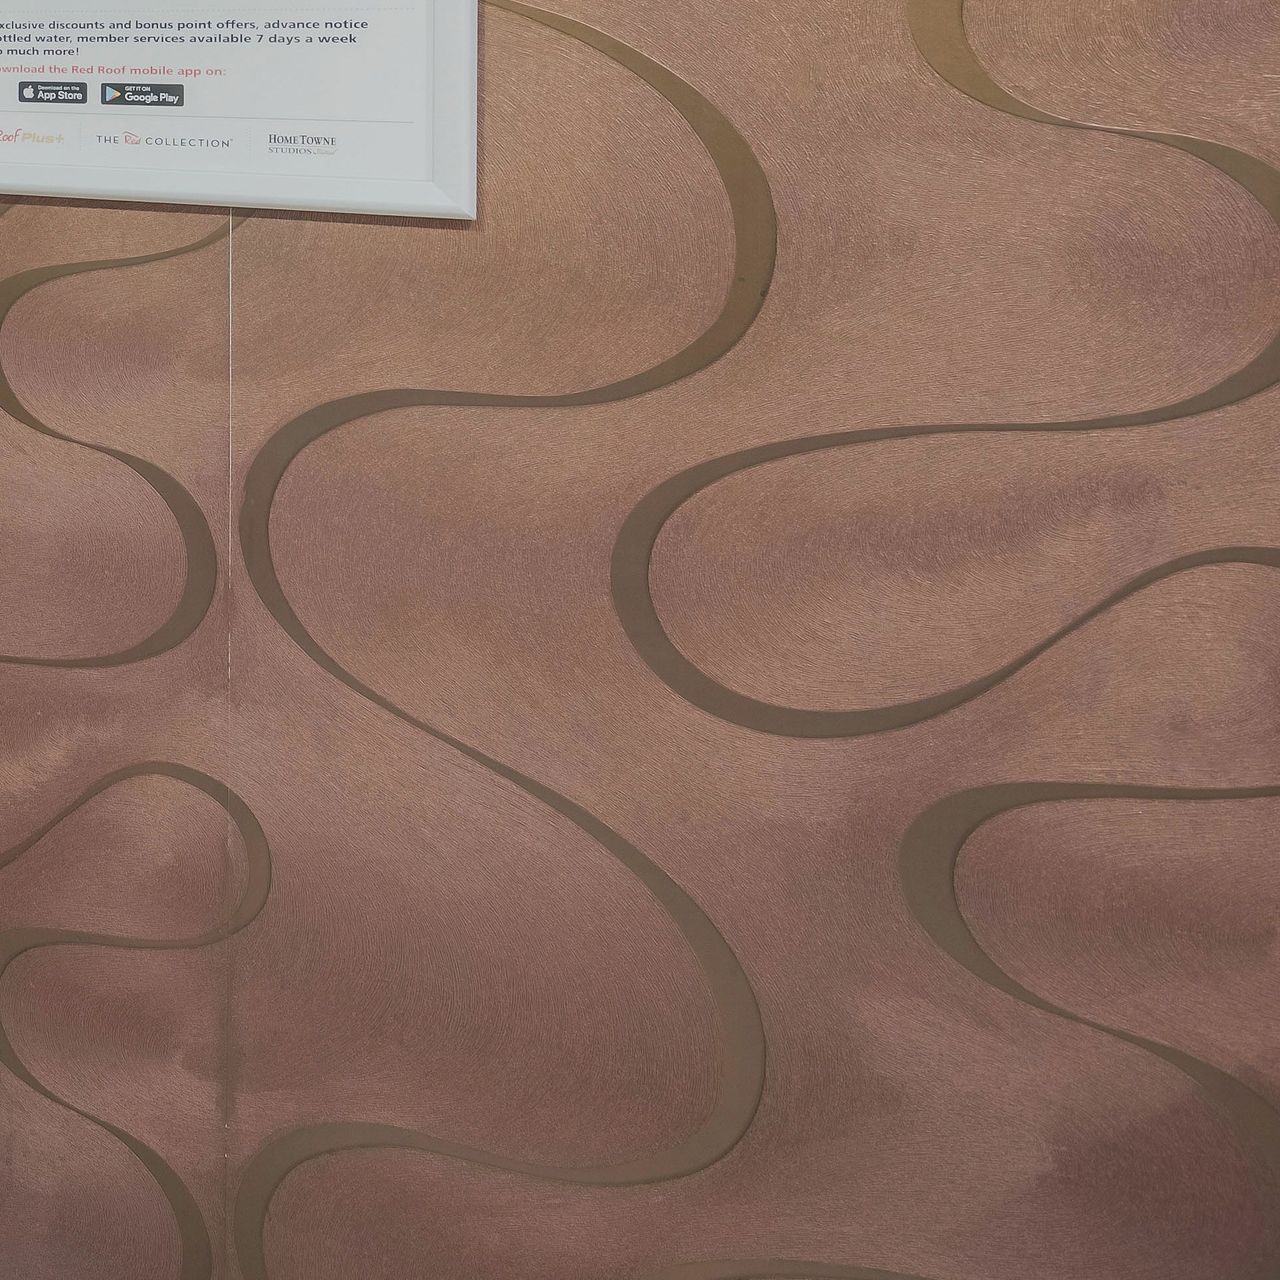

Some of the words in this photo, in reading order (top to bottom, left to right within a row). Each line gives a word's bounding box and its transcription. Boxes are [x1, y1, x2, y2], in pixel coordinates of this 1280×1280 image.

[49, 20, 105, 30] discounts
[109, 20, 131, 30] and
[135, 20, 174, 30] bonus
[177, 20, 212, 31] point
[216, 19, 259, 30] offers,
[264, 20, 320, 29] advance
[325, 19, 369, 29] notice
[35, 34, 73, 44] water,
[77, 33, 130, 43] member
[133, 33, 185, 43] services
[189, 33, 252, 43] available
[268, 33, 300, 45] days
[318, 33, 357, 43] week
[6, 47, 39, 56] much
[43, 47, 80, 56] more!
[72, 65, 93, 74] Red
[98, 65, 126, 75] Roof
[130, 65, 173, 75] mobile
[38, 91, 56, 101] App
[57, 91, 83, 101] Store
[125, 91, 158, 104] Google
[159, 93, 179, 104] Play
[97, 135, 119, 145] THE
[145, 137, 230, 148] COLLECTION
